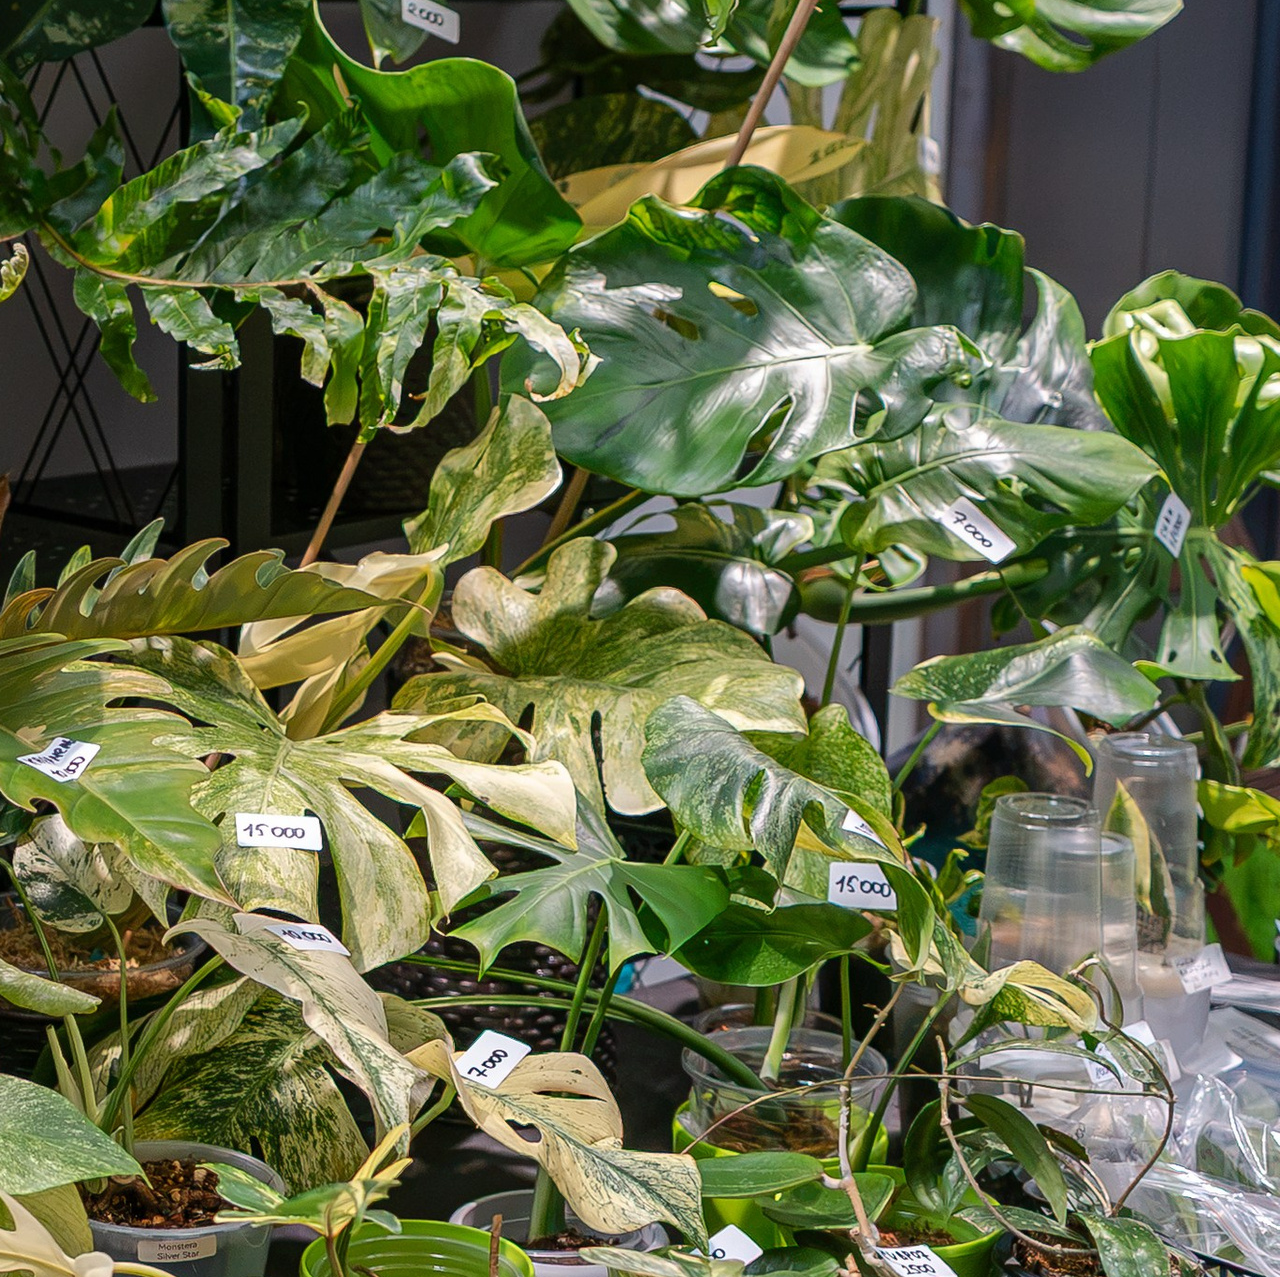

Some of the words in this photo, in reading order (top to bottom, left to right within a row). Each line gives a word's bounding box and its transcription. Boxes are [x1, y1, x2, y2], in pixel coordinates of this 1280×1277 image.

[158, 1241, 198, 1251] Monstera
[156, 1252, 180, 1261] Silver
[182, 1250, 200, 1259] Star
